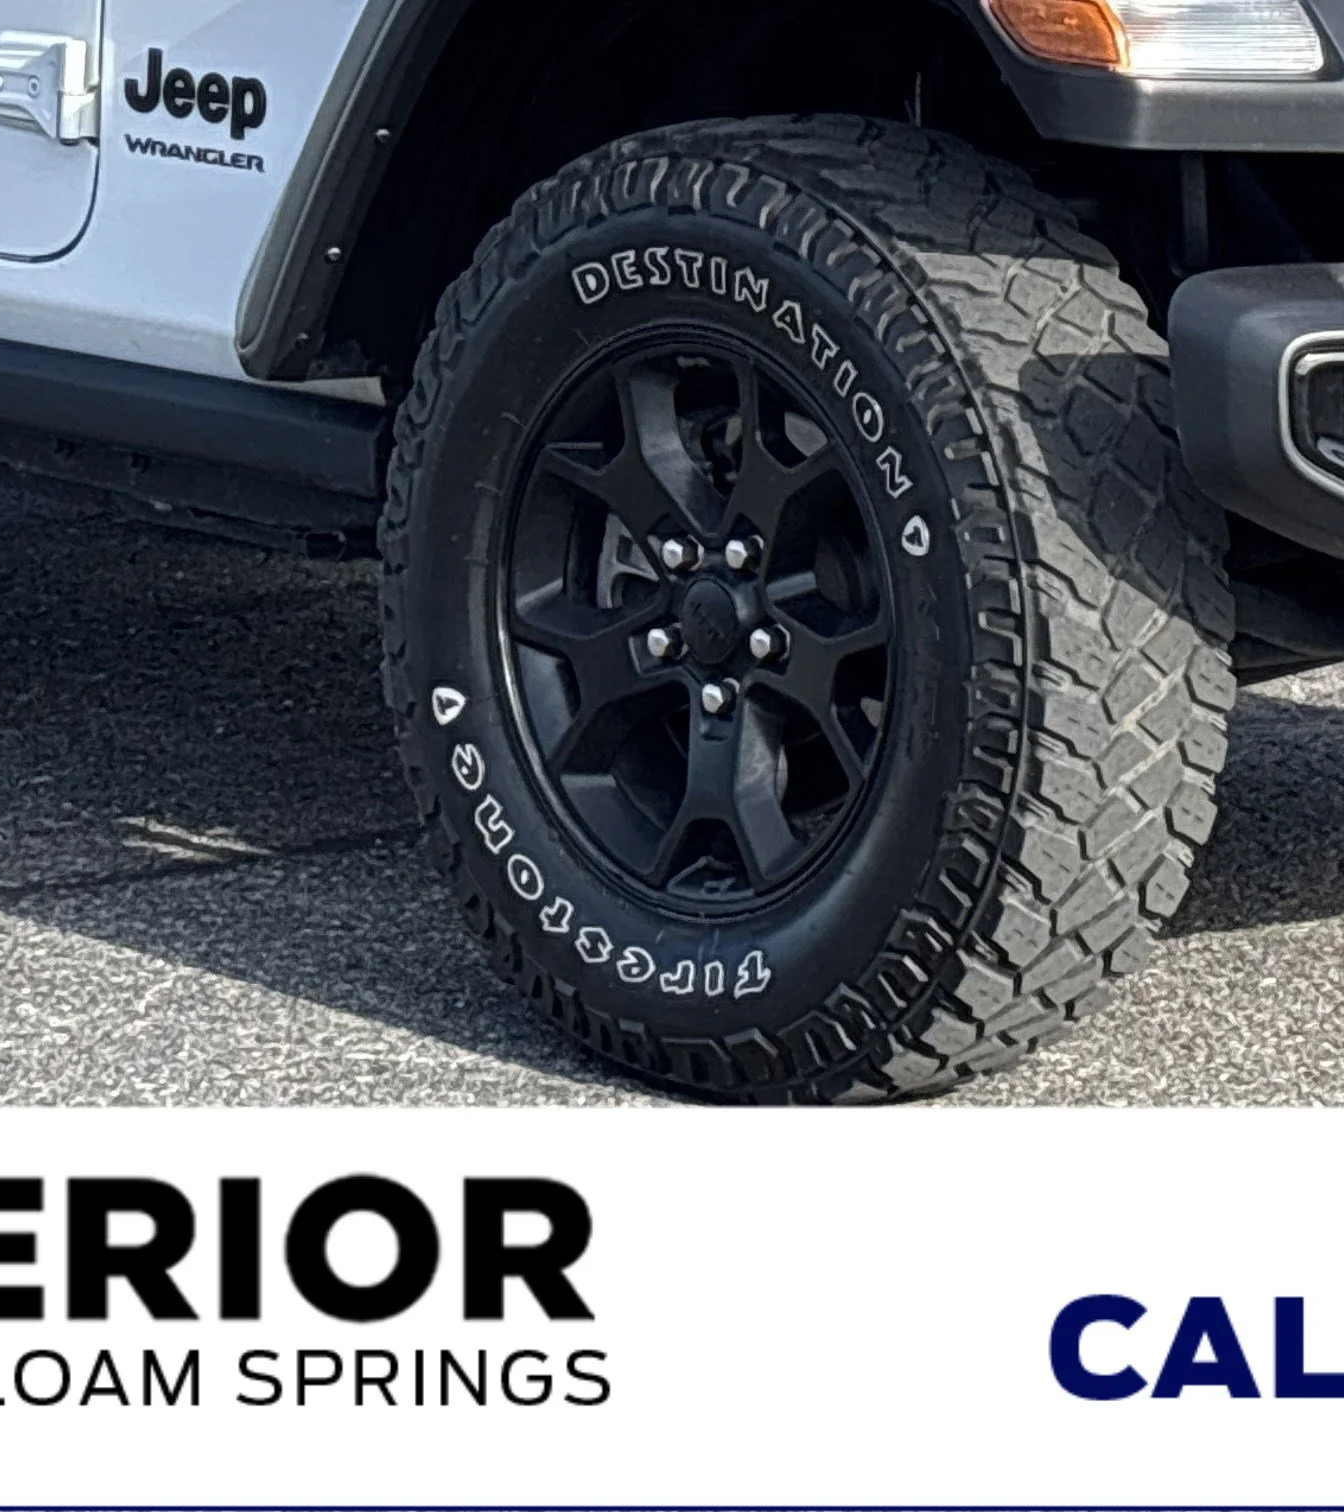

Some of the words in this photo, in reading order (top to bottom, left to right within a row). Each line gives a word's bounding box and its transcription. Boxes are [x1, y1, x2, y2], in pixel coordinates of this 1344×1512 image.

[124, 47, 267, 141] Jeep
[123, 133, 266, 173] WRANGLER
[571, 245, 913, 500] DESTINATION
